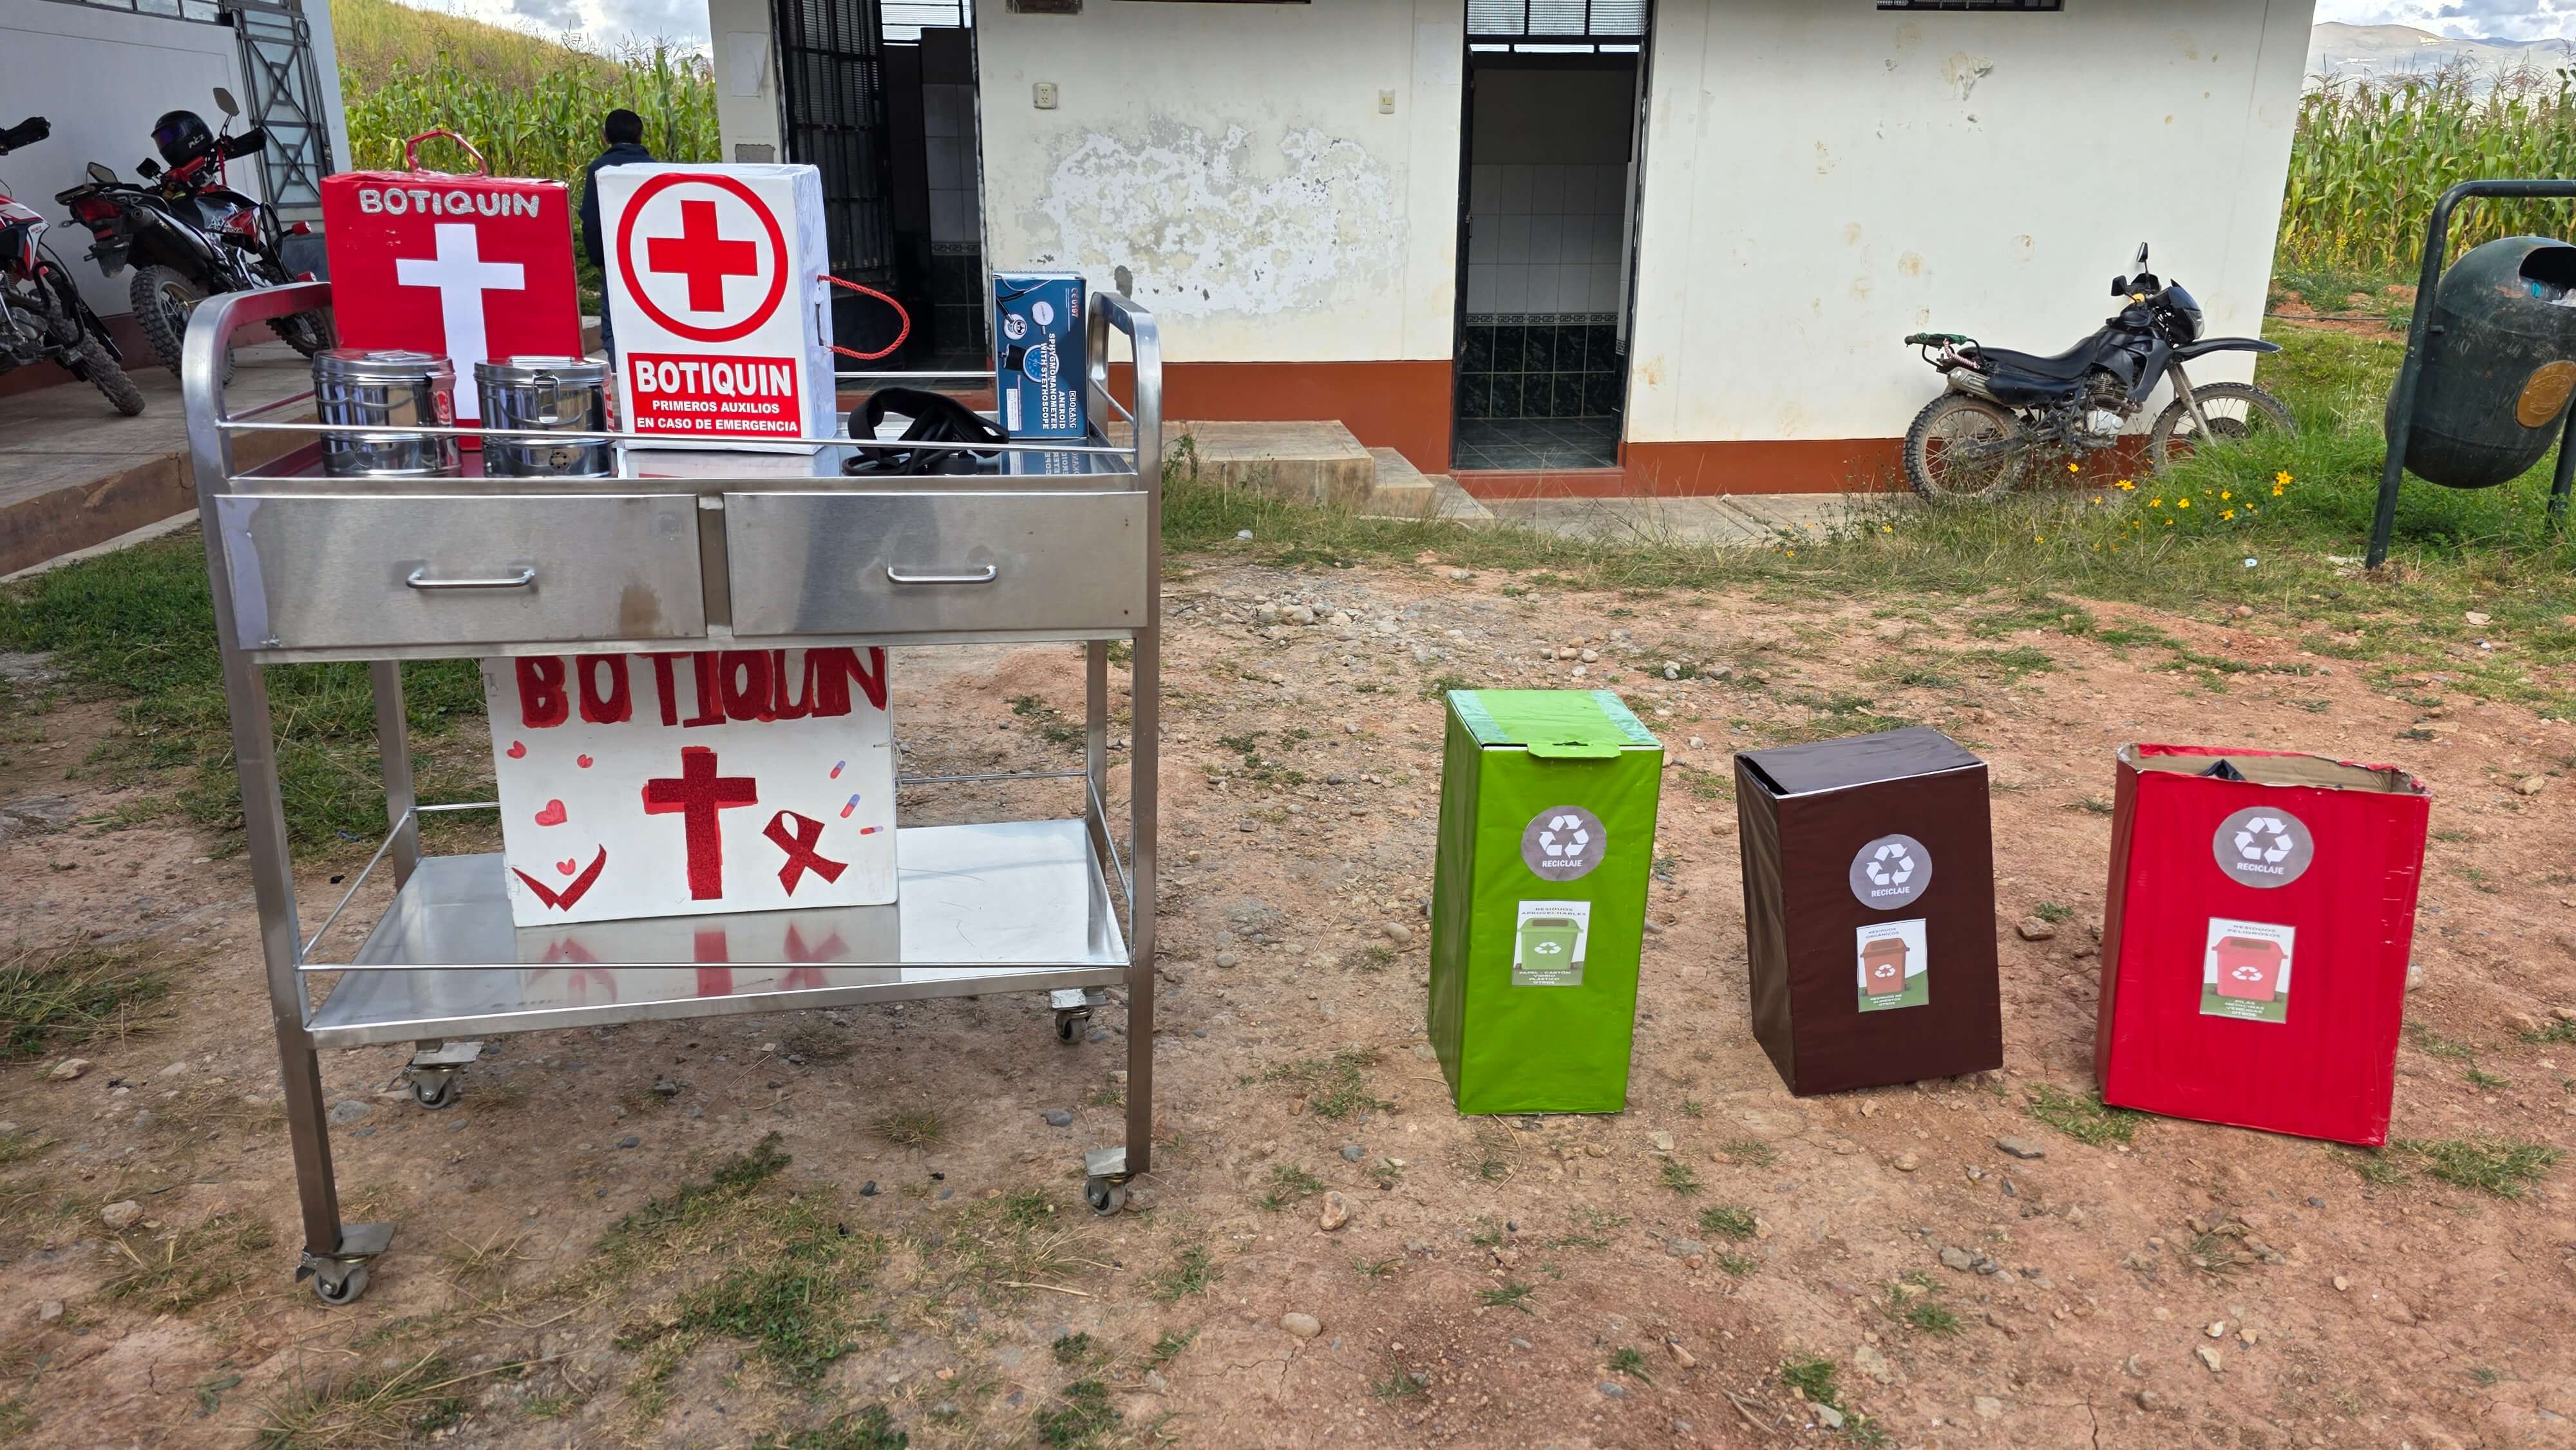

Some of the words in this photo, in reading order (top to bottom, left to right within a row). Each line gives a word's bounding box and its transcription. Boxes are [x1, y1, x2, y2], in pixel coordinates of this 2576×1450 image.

[359, 187, 540, 218] BOTIQUIN
[635, 360, 793, 398] BOTIQUIN
[1048, 333, 1057, 430] SPHYGMOMANOMETER
[652, 399, 717, 413] PRIMEROS
[720, 401, 781, 414] AUXILIOS
[1041, 366, 1049, 430] STETHOSCOPE
[637, 417, 655, 429] EN
[658, 418, 692, 431] CASO
[695, 419, 712, 431] DE
[715, 419, 799, 433] EMERGENCIA
[2237, 862, 2284, 874] RECICLAJE
[1871, 886, 1910, 897] RECICLAJE
